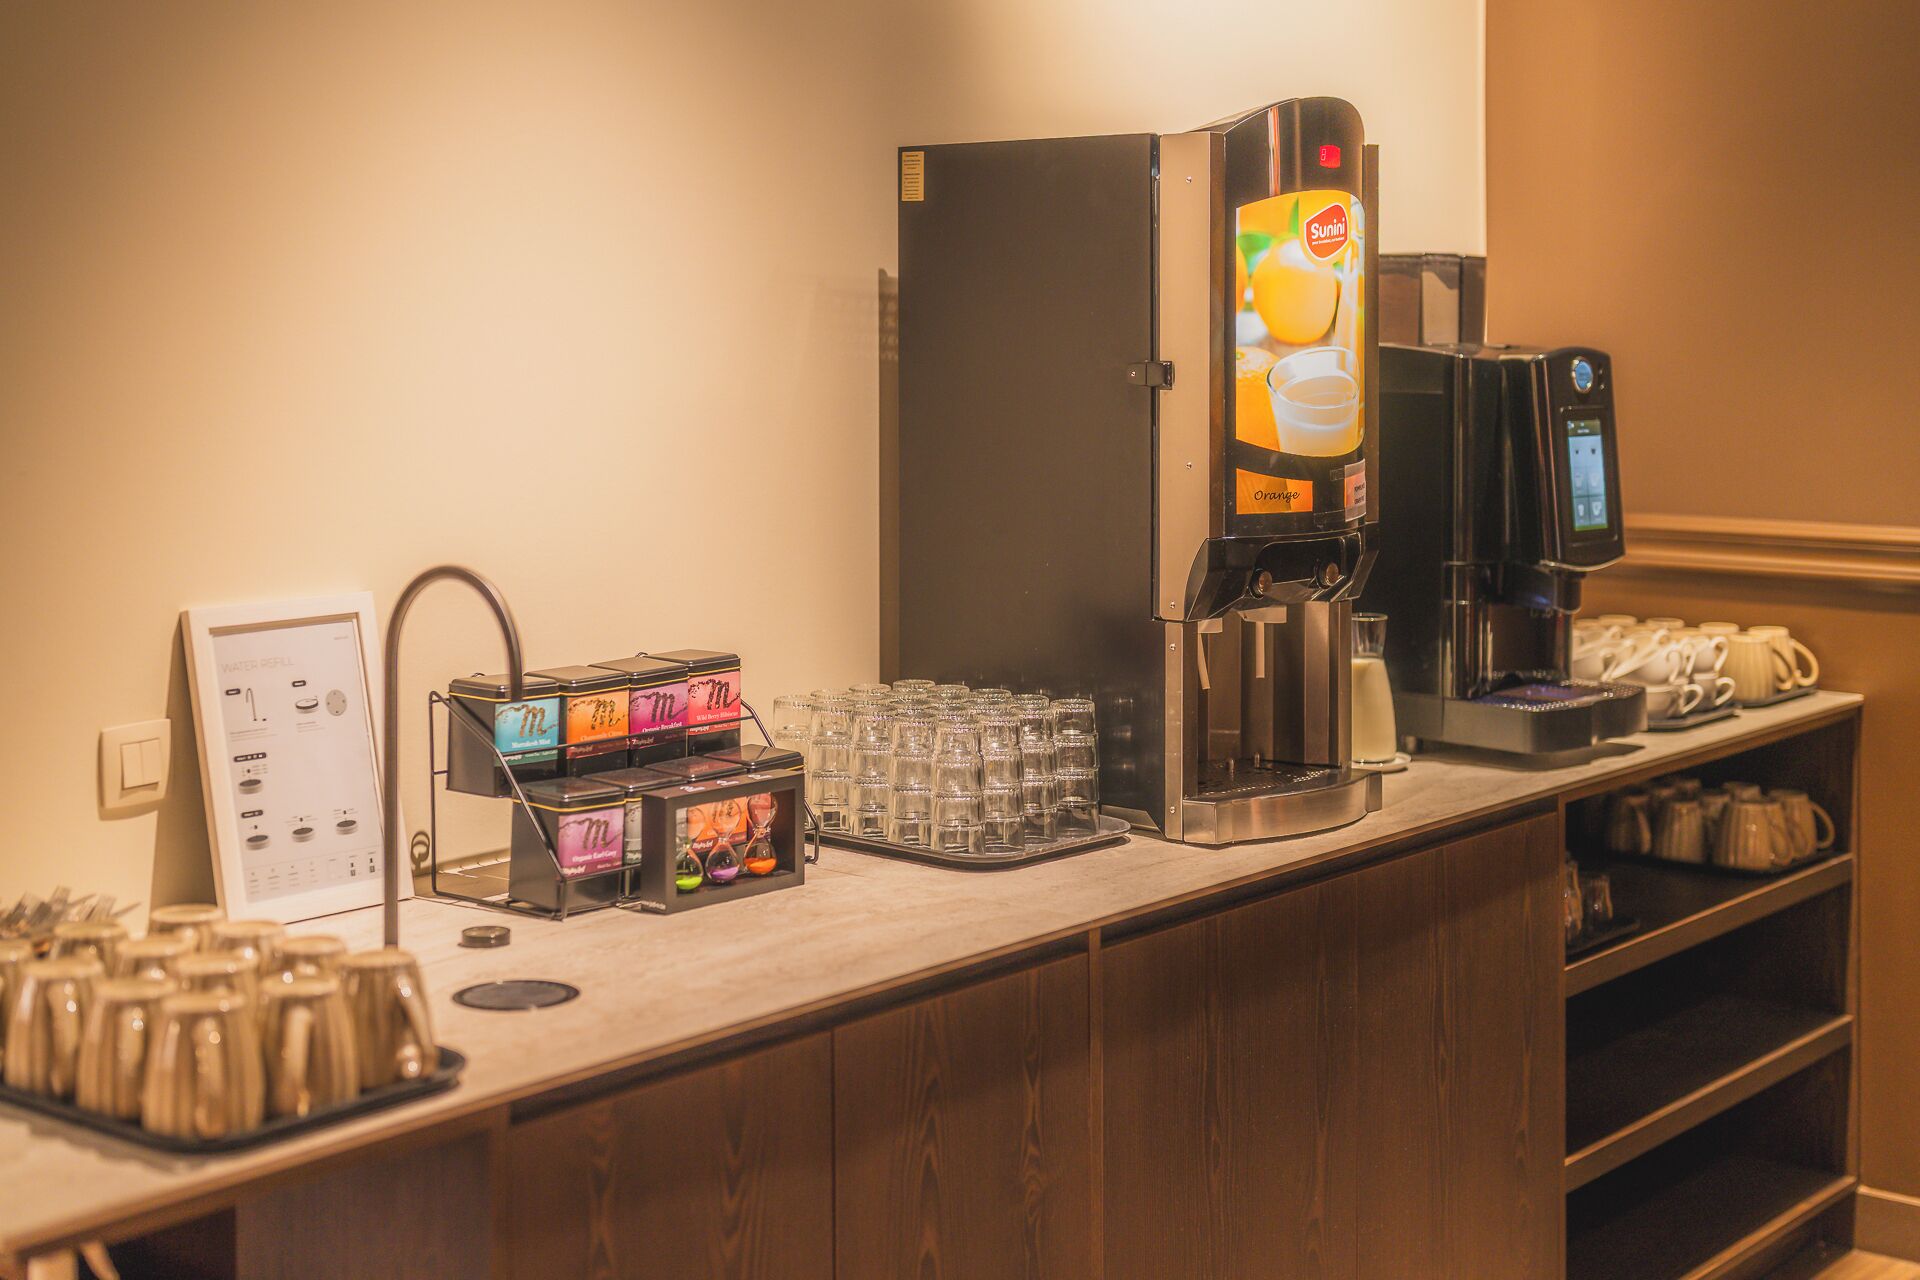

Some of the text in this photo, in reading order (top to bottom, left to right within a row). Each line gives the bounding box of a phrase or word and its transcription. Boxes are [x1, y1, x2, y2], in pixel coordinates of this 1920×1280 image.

[1310, 217, 1345, 239] Sunini
[1254, 490, 1300, 503] Orange
[221, 657, 295, 673] WATER REFILL
